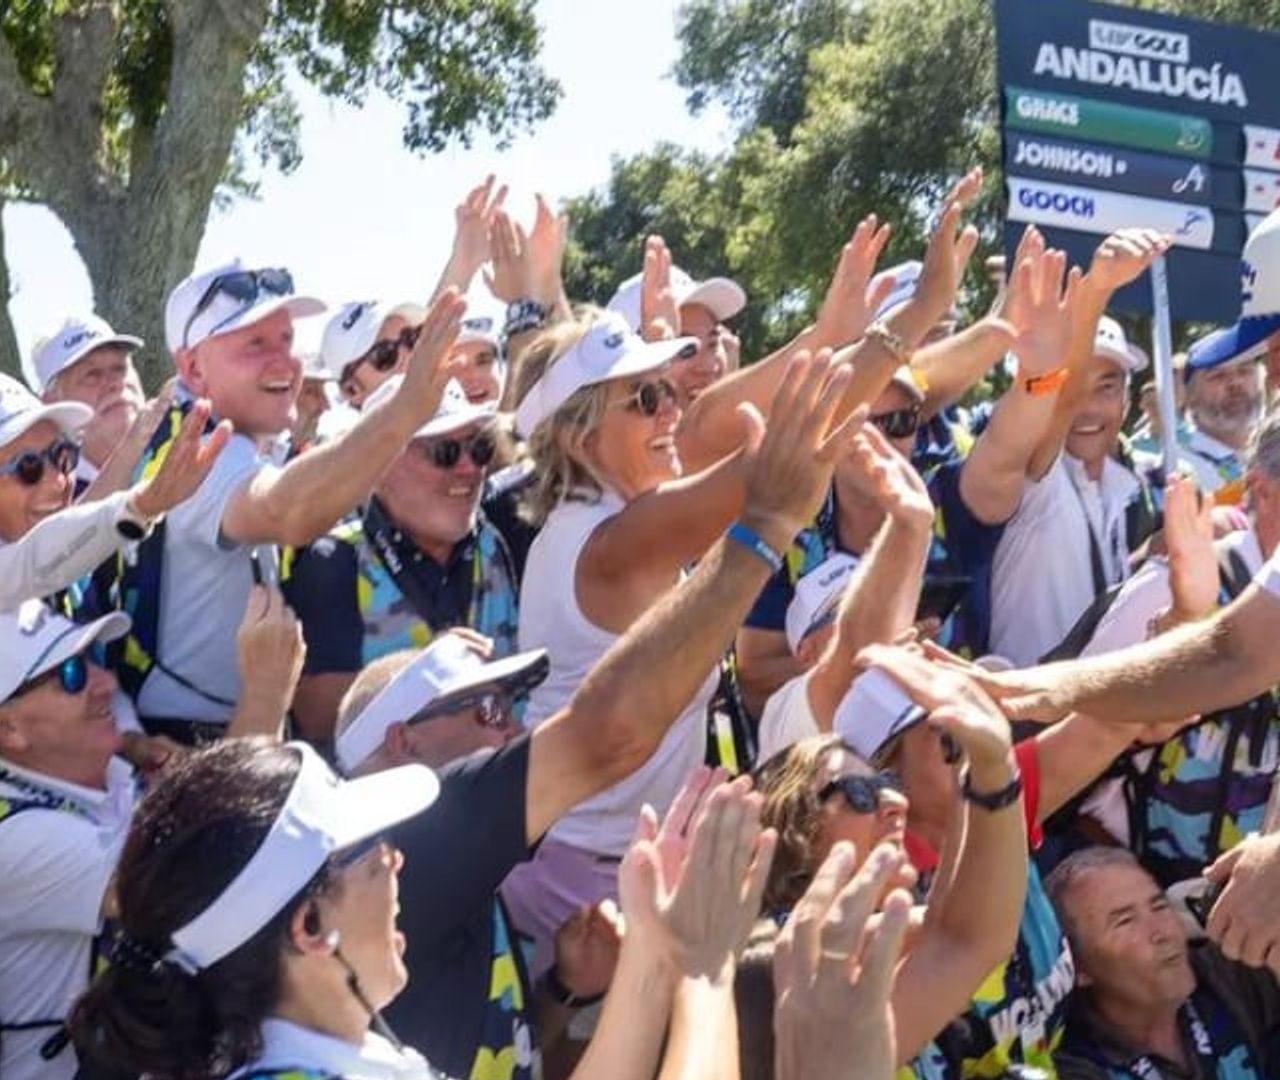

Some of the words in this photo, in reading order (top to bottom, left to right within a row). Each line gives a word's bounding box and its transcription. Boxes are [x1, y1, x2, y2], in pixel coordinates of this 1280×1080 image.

[1033, 42, 1248, 107] ANDALUCÍA
[1014, 141, 1114, 178] JOHNSON
[1019, 188, 1095, 218] GOOCH
